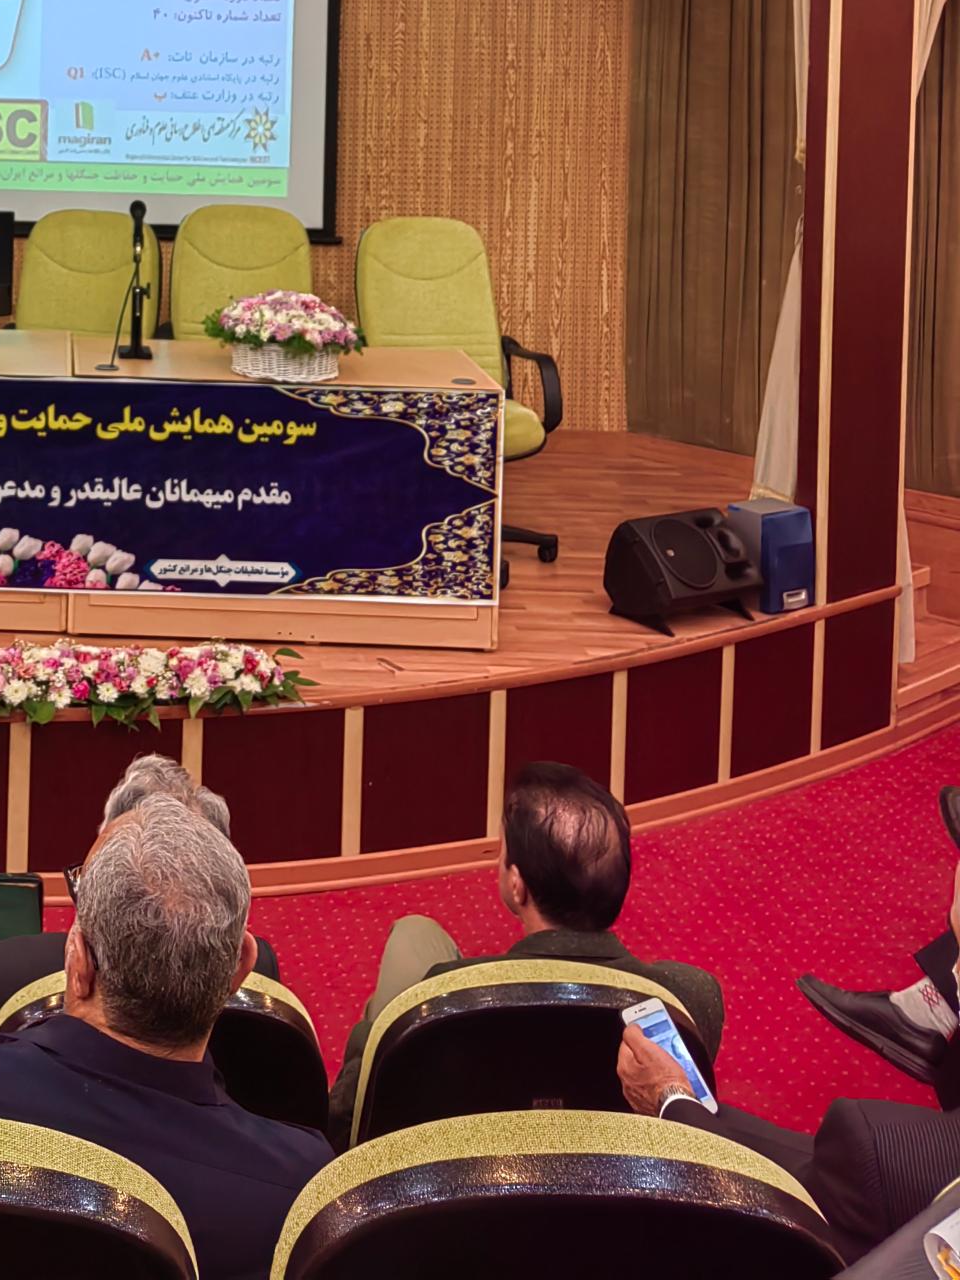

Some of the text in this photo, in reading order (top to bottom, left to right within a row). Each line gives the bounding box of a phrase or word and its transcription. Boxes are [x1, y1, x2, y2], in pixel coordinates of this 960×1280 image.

[174, 8, 213, 22] تاکنون:
[216, 8, 249, 23] شماره
[252, 9, 281, 22] تعداد
[199, 51, 238, 65] سازمان
[241, 54, 254, 67] در
[258, 54, 281, 67] رتبه
[244, 72, 257, 85] در
[259, 73, 280, 86] رتبه
[202, 89, 237, 104] وزارت
[240, 91, 254, 103] در
[258, 91, 280, 104] رتبه
[58, 133, 112, 148] magiran
[12, 404, 93, 432] حمایت
[96, 407, 146, 441] ملی
[149, 407, 232, 442] همایش
[238, 412, 317, 445] سومین
[47, 487, 61, 508] و
[65, 476, 142, 508] عالیقدر
[146, 483, 235, 510] میهمانان
[237, 485, 292, 511] مقدم
[158, 563, 178, 575] کشور
[178, 564, 199, 575] مراتع
[233, 565, 264, 577] تحقیقات
[264, 567, 289, 579] مؤسسه
